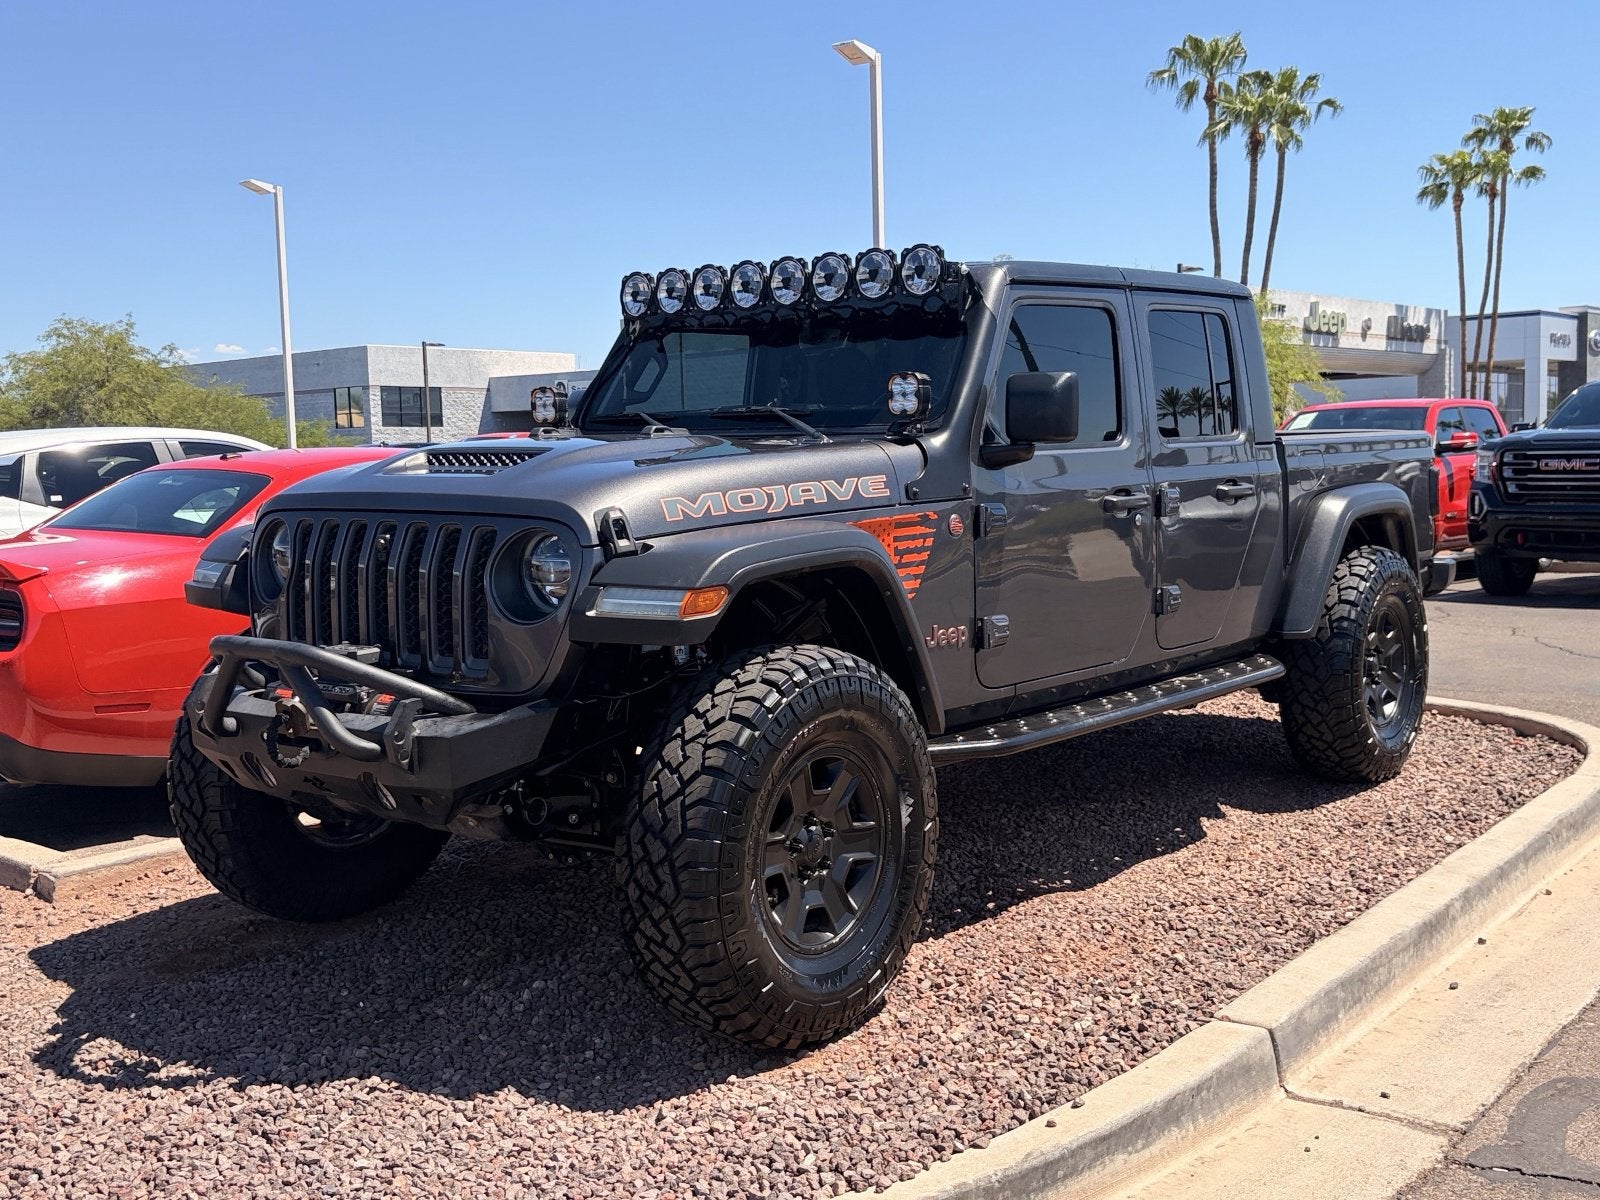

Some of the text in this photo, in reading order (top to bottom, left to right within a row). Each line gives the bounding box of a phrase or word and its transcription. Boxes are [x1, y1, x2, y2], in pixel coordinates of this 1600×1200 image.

[1306, 301, 1347, 338] Jeep
[1539, 458, 1600, 470] GMC
[660, 474, 890, 522] MOJAVE
[925, 624, 968, 650] Jeep
